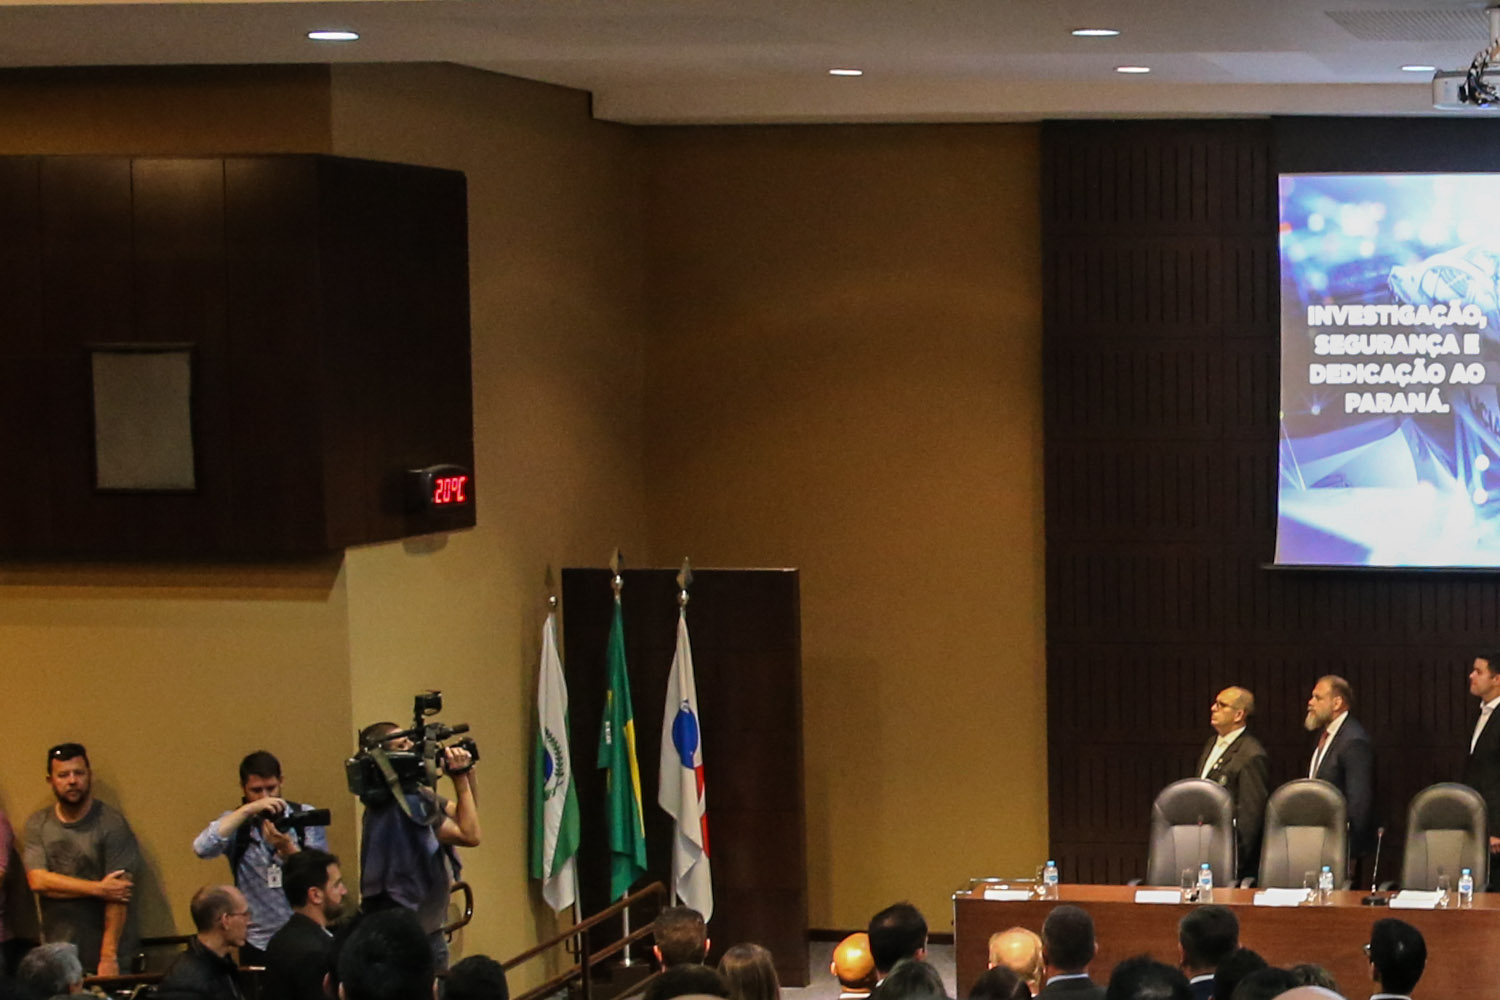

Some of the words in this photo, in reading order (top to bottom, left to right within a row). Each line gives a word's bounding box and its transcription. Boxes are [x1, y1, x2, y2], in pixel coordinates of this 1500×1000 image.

[1308, 300, 1487, 329] INVESTIGAÇÃO,
[1314, 333, 1460, 358] SEGURANÇA
[1463, 334, 1480, 355] E
[1309, 358, 1446, 387] DEDICAÇÃO
[1449, 363, 1486, 384] AO
[1345, 388, 1450, 413] PARANÁ.
